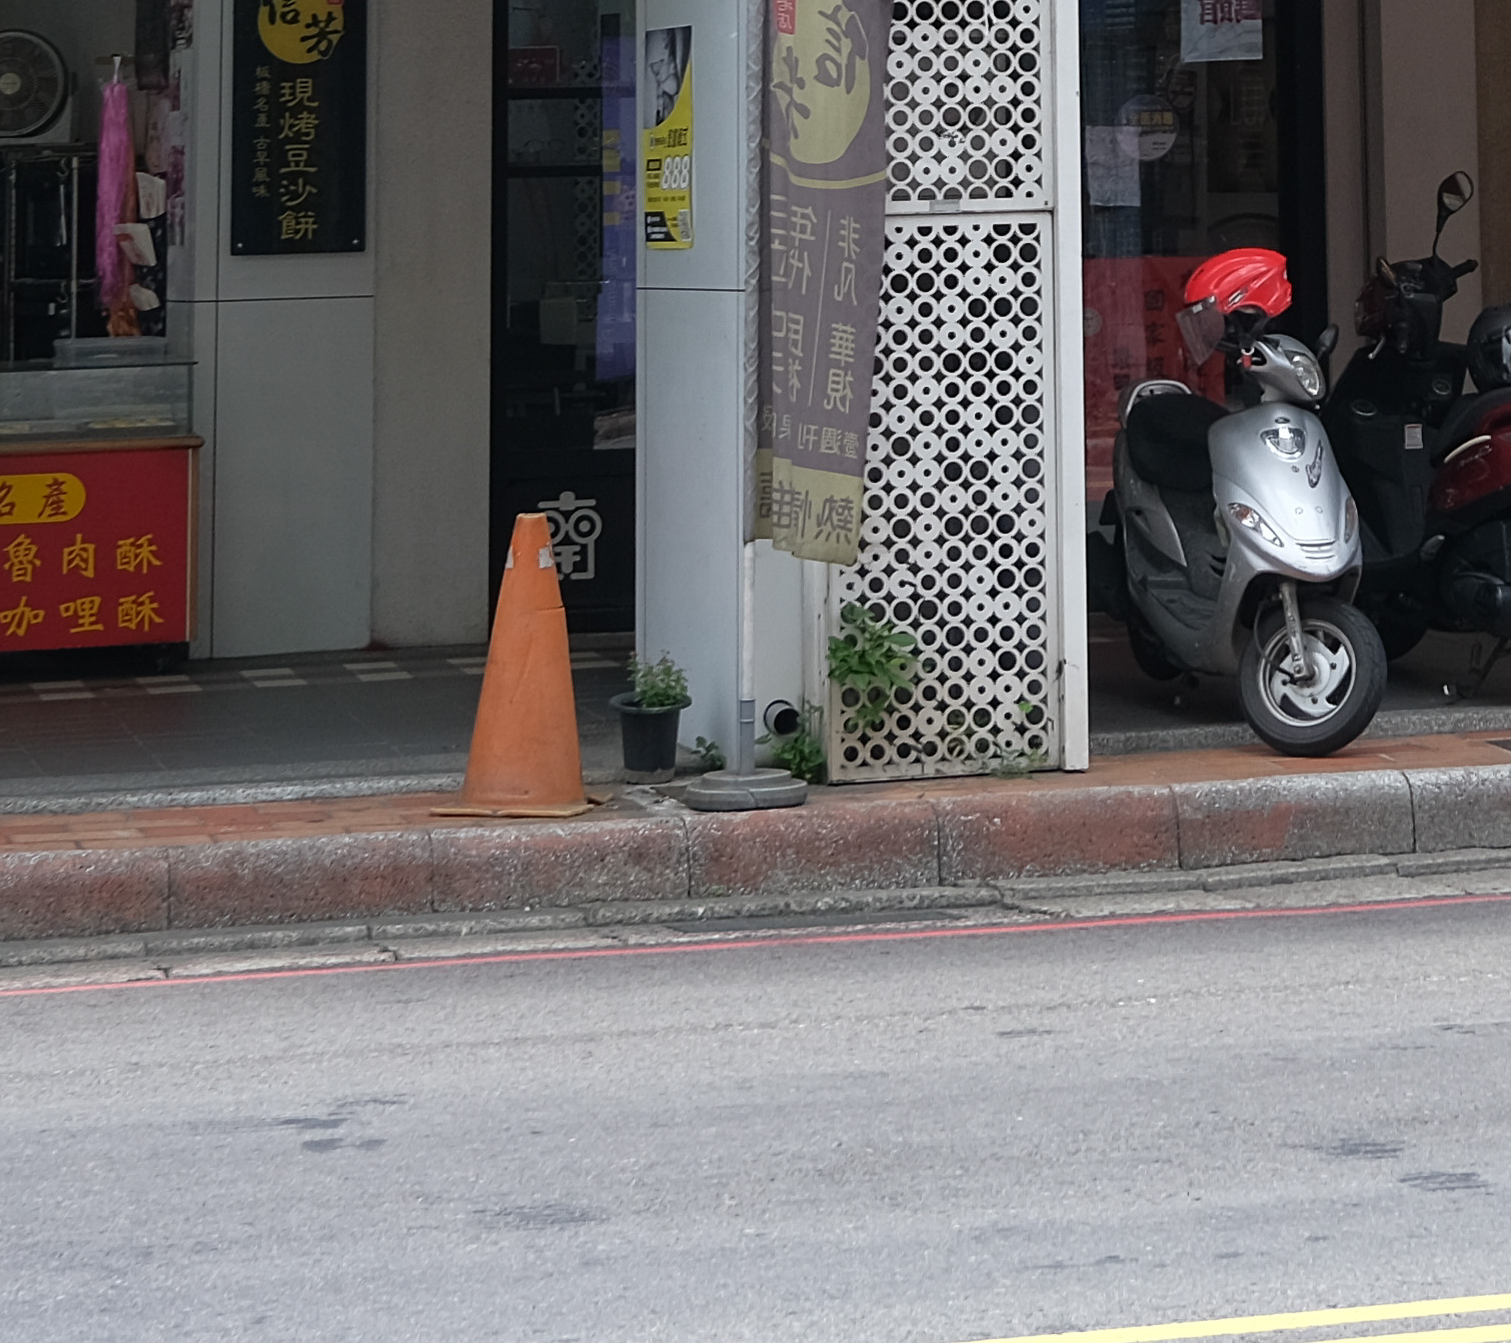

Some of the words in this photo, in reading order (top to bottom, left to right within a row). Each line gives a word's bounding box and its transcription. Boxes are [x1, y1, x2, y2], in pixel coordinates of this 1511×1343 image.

[279, 78, 320, 240] 現烤豆沙餅
